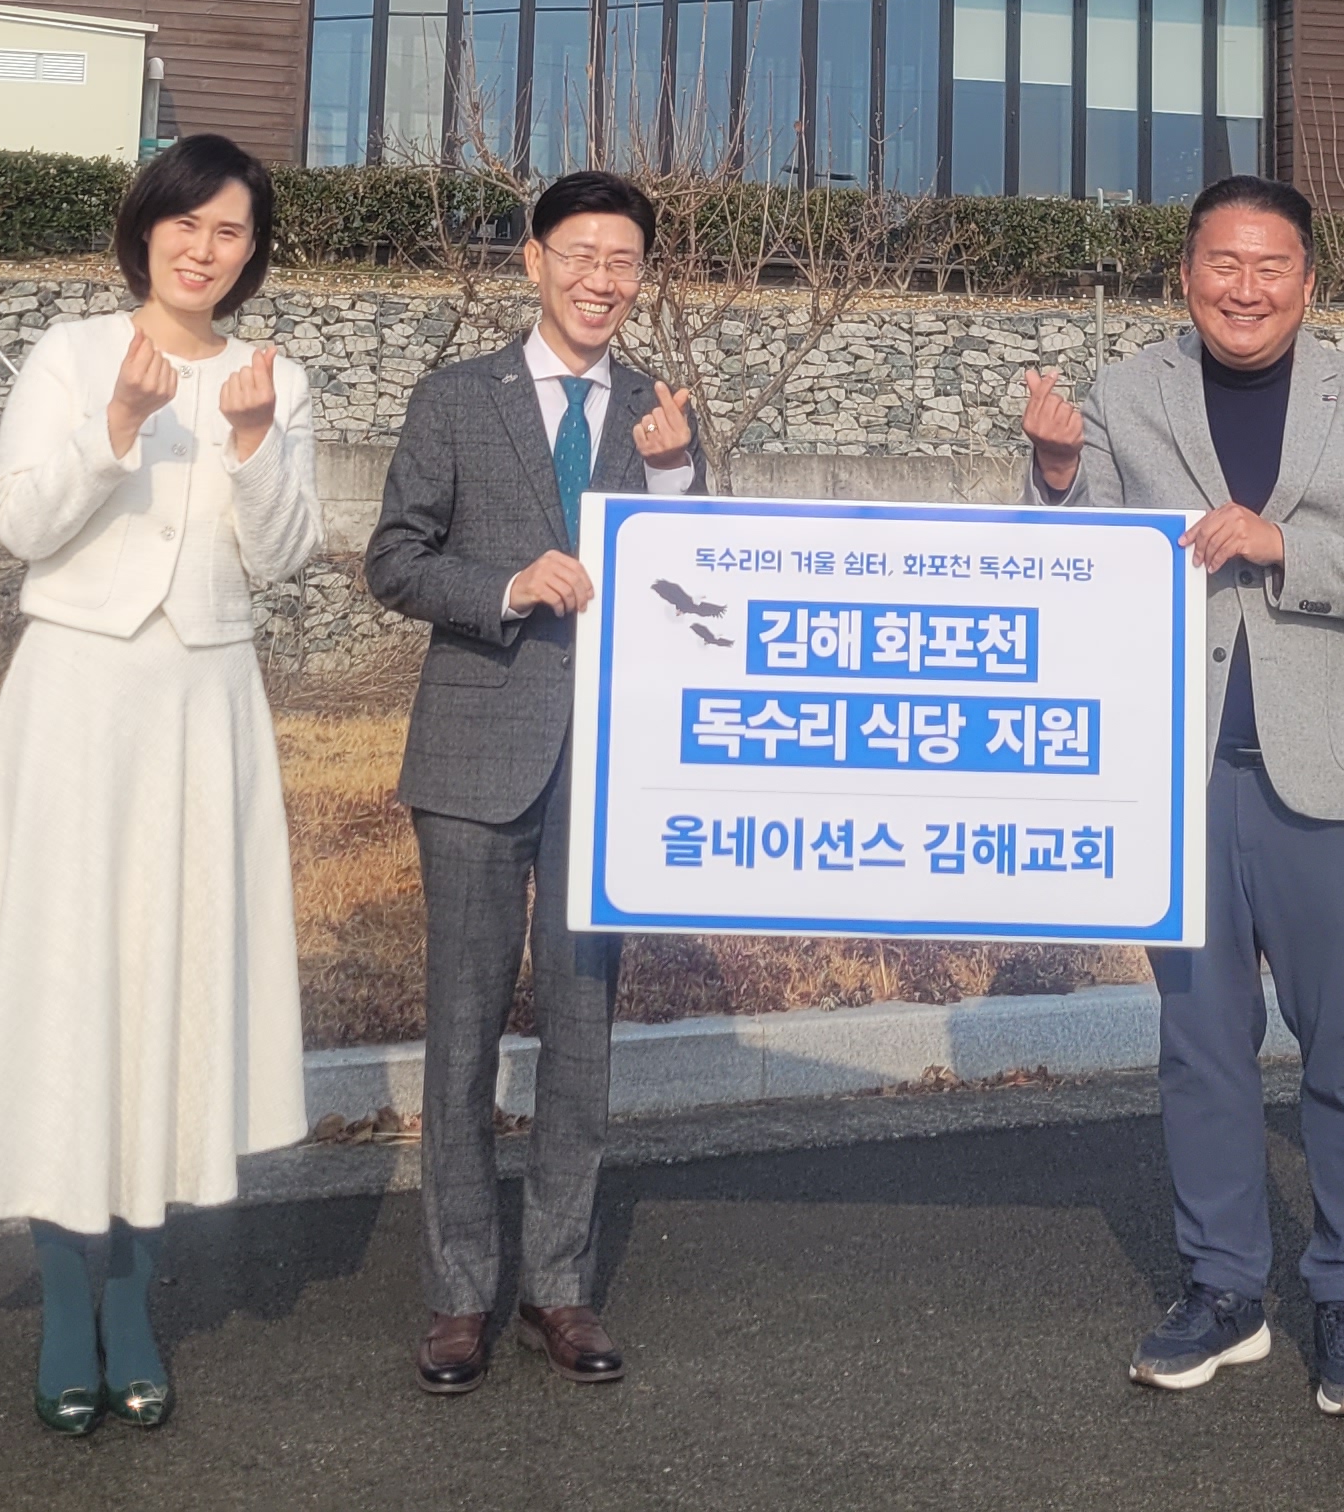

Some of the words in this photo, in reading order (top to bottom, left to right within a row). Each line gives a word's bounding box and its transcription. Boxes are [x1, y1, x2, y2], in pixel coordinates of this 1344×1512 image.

[695, 546, 782, 574] 독수리의
[790, 550, 837, 576] 겨울
[843, 550, 895, 578] 쉼터,
[902, 553, 972, 580] 화포천
[978, 555, 1044, 582] 독수리
[1050, 557, 1095, 583] 식당
[759, 608, 862, 671] 김해
[872, 611, 1028, 675] 화포천
[692, 697, 848, 761] 독수리
[859, 701, 967, 763] 식당
[985, 704, 1090, 767] 지원
[660, 814, 906, 872] 올네이션스
[922, 821, 1116, 879] 김해교회
